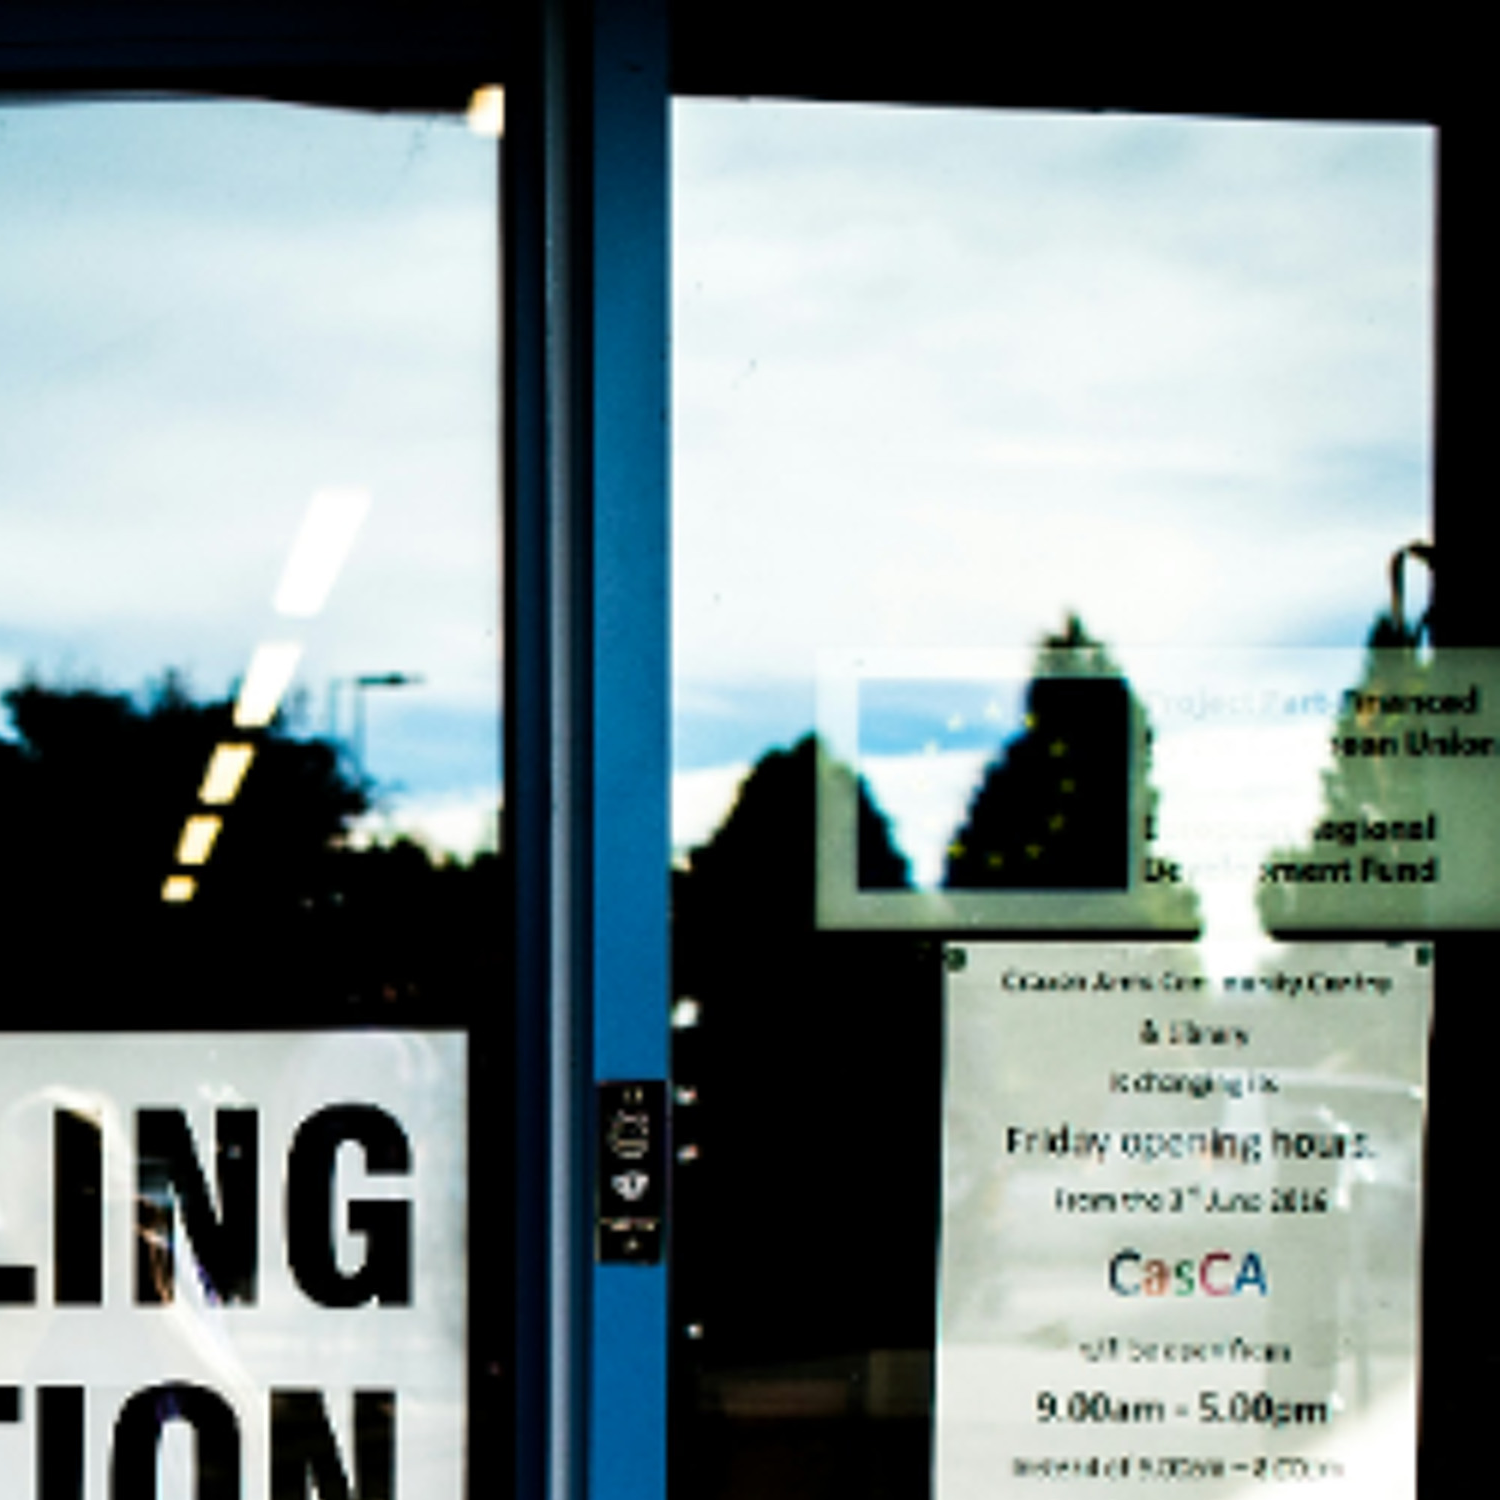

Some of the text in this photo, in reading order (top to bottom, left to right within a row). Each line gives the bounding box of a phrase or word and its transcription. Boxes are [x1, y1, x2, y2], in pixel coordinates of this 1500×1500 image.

[1404, 728, 1496, 757] Union
[1312, 813, 1436, 846] egional
[1361, 856, 1440, 884] Fund
[1140, 1019, 1159, 1045] &
[1134, 1071, 1243, 1098] changing
[1006, 1126, 1110, 1161] Friday
[1121, 1128, 1263, 1163] opening
[1121, 1189, 1163, 1213] the
[1109, 1248, 1268, 1297] CasCA
[1037, 1392, 1164, 1424] 9.00am
[1199, 1392, 1329, 1430] 5.00pm
